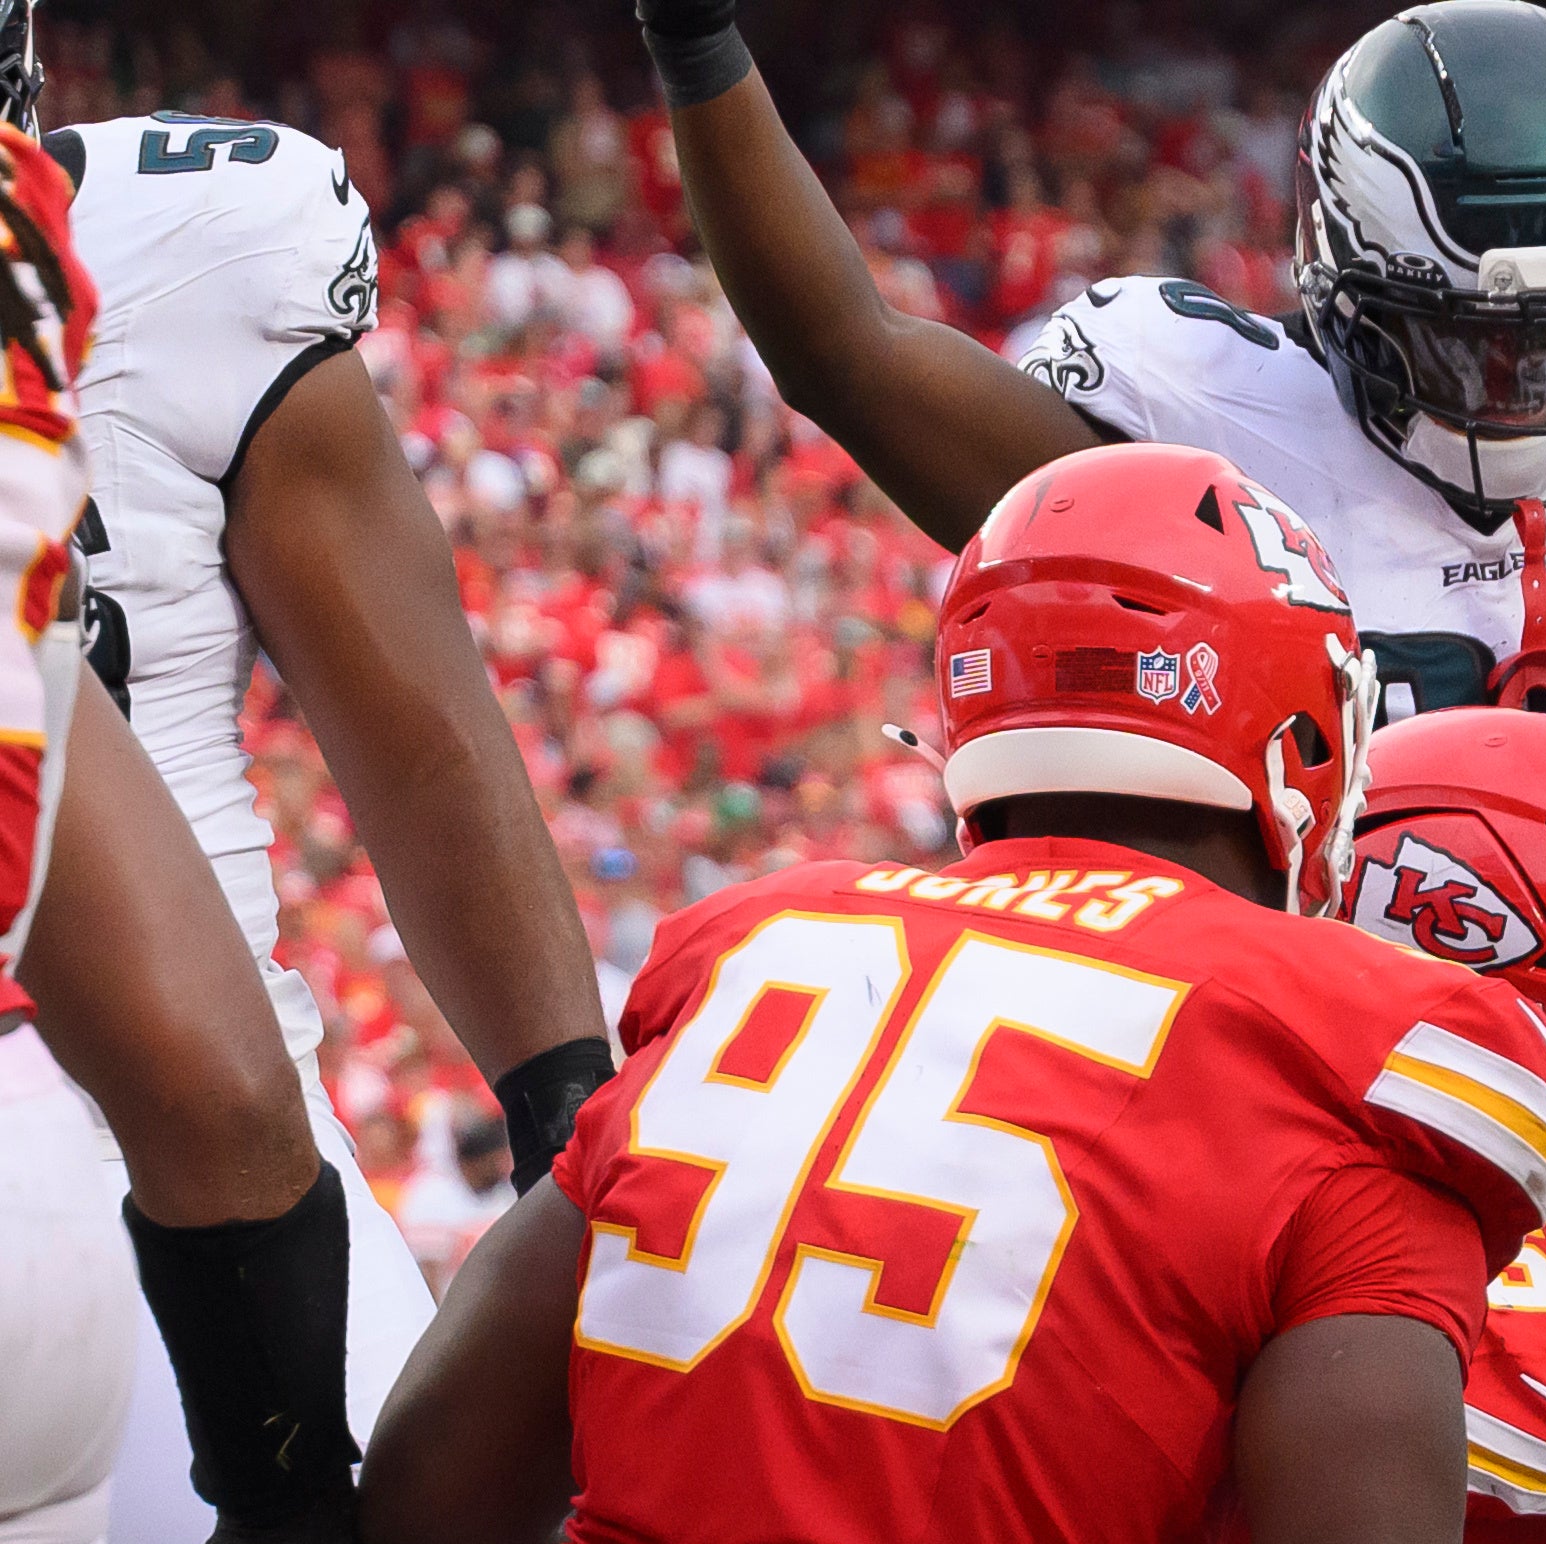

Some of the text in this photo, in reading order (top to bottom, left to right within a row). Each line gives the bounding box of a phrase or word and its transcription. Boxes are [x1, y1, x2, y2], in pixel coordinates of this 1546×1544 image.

[1442, 552, 1527, 588] EAGLE
[855, 866, 1184, 932] JONES
[1384, 865, 1508, 965] KC
[574, 908, 1193, 1433] 95
